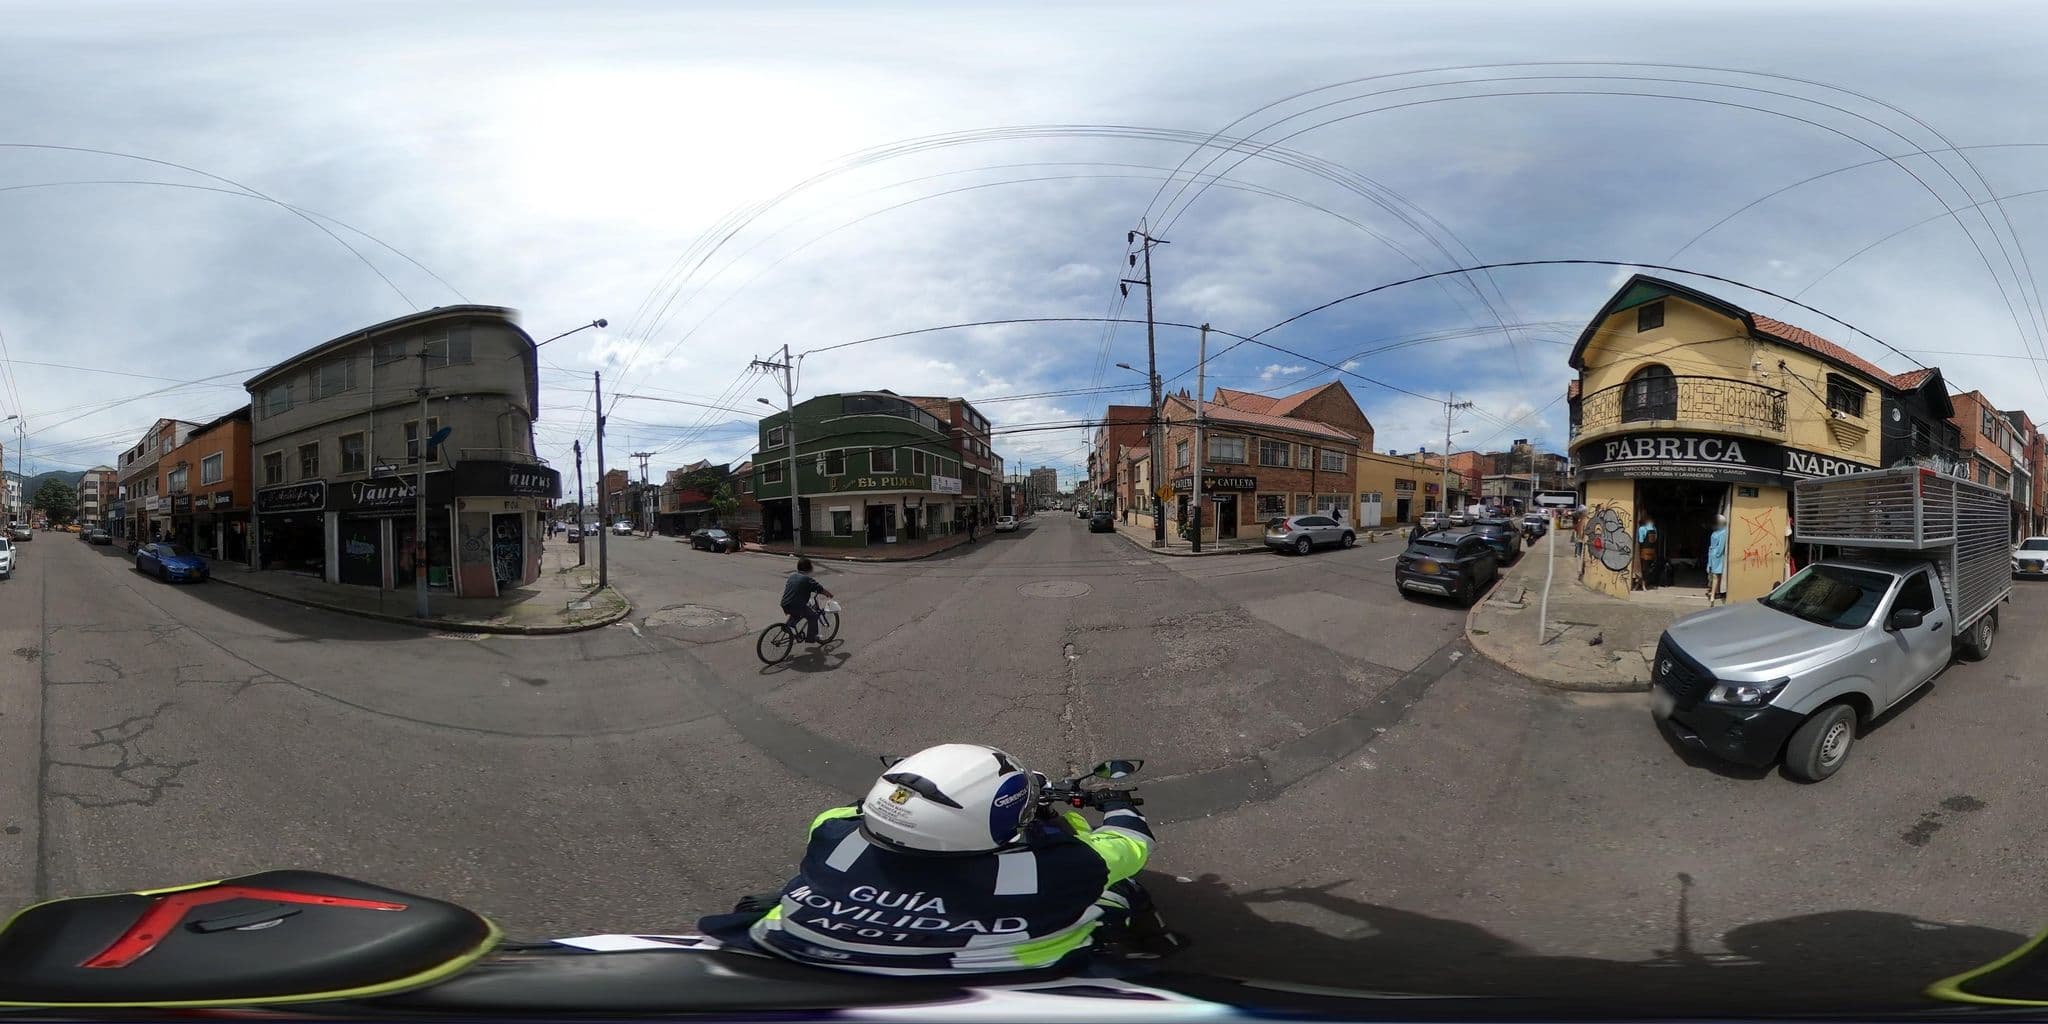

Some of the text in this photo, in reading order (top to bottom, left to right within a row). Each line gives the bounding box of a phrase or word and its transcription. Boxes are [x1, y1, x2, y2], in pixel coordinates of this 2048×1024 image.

[1604, 437, 1746, 463] FÁBRICA
[352, 481, 417, 504] Taurus
[857, 477, 877, 488] EL
[1217, 478, 1254, 488] CATLEYA
[790, 885, 1029, 934] MOVILIDAD
[849, 885, 945, 914] GUÍA
